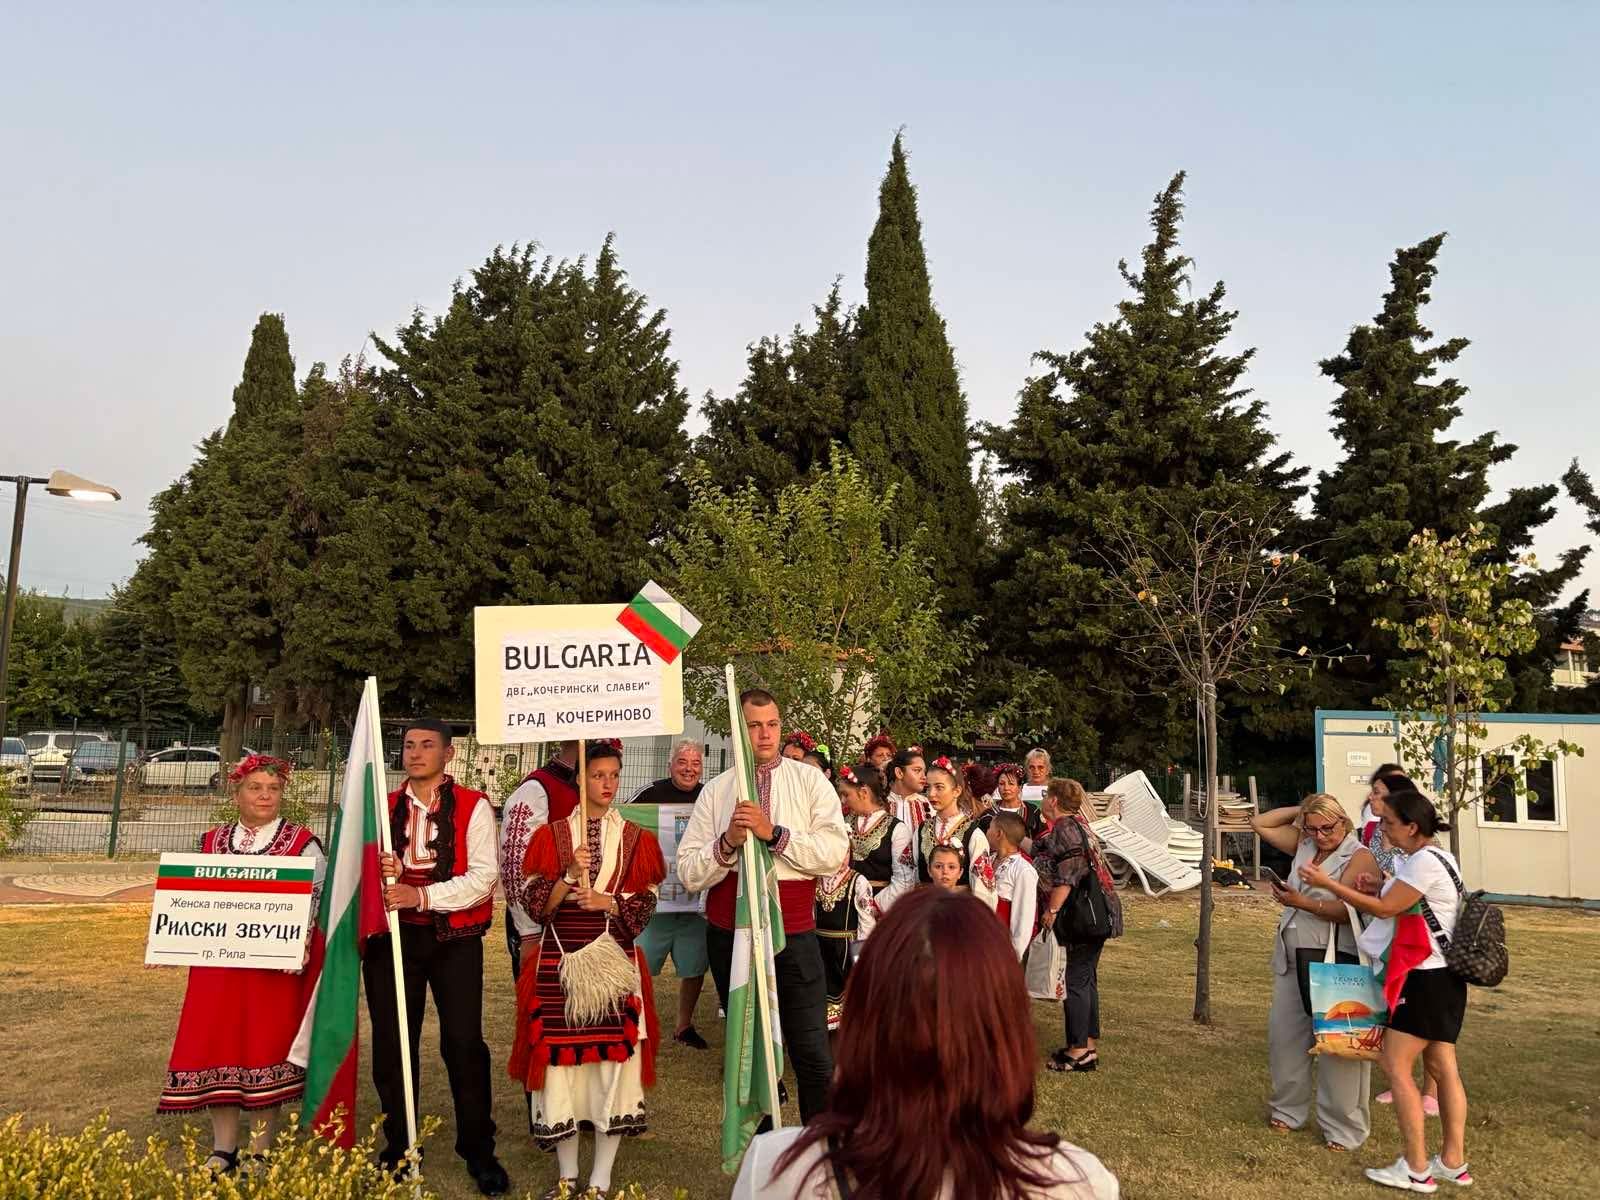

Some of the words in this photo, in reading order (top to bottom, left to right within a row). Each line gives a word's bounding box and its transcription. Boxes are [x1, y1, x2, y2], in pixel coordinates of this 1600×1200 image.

[505, 642, 652, 670] BULGARIA
[507, 712, 546, 727] ГРАД
[556, 708, 652, 724] КОЧЕРИНОВО
[194, 866, 278, 880] BULGARIA
[170, 898, 211, 909] Женска
[213, 901, 261, 911] певческа
[264, 903, 293, 913] група
[202, 950, 216, 960] гр.
[219, 948, 246, 959] Рила
